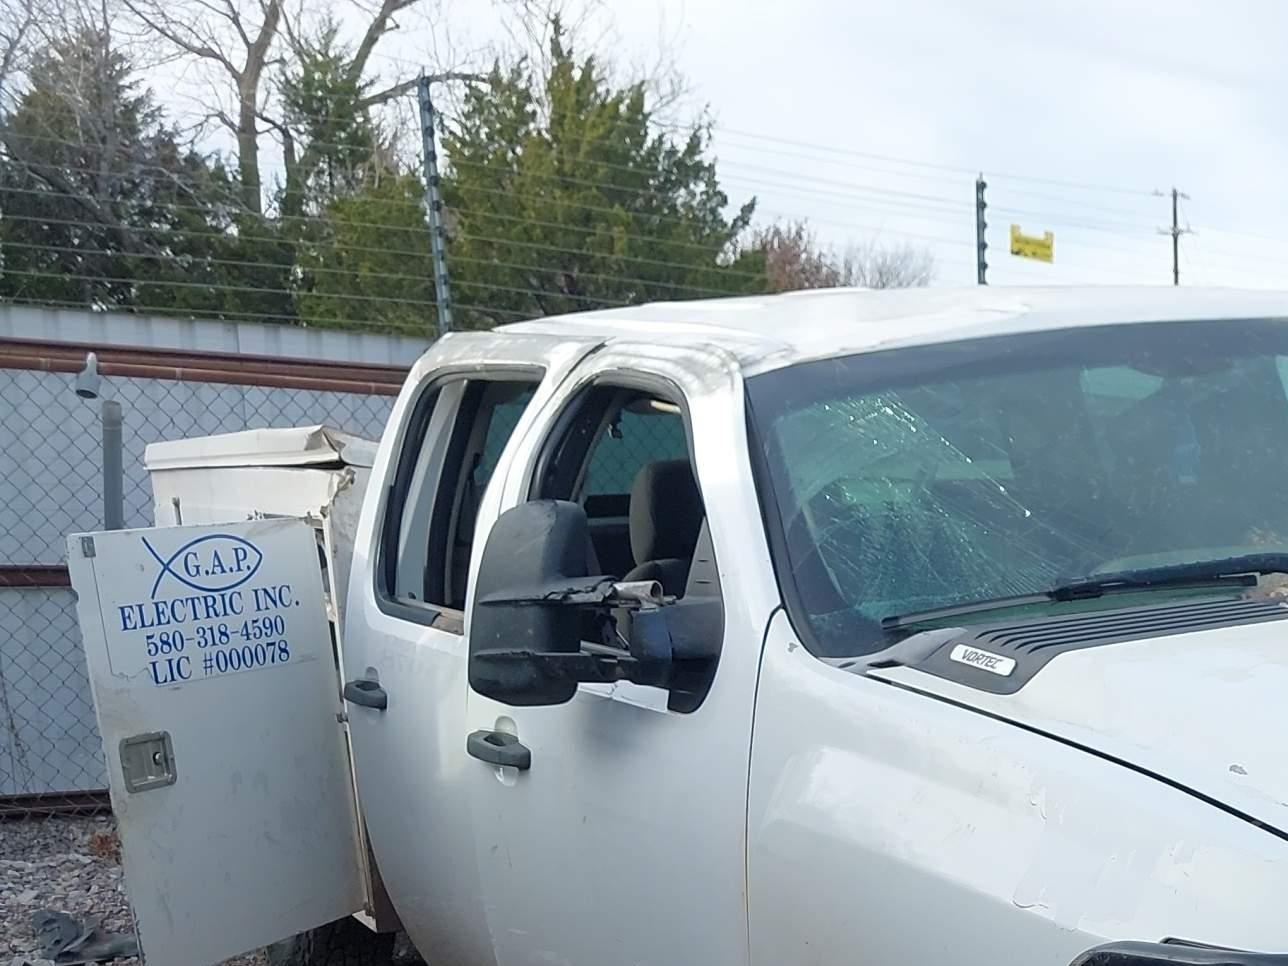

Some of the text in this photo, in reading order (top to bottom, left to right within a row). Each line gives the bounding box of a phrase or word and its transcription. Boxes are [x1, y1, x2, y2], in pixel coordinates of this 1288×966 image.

[183, 547, 251, 577] G.A.P.
[118, 584, 300, 631] ELECTRIC INC.
[145, 614, 285, 657] 580-318-4590
[149, 640, 290, 686] LIC #000078
[962, 648, 1004, 670] VORTEC
